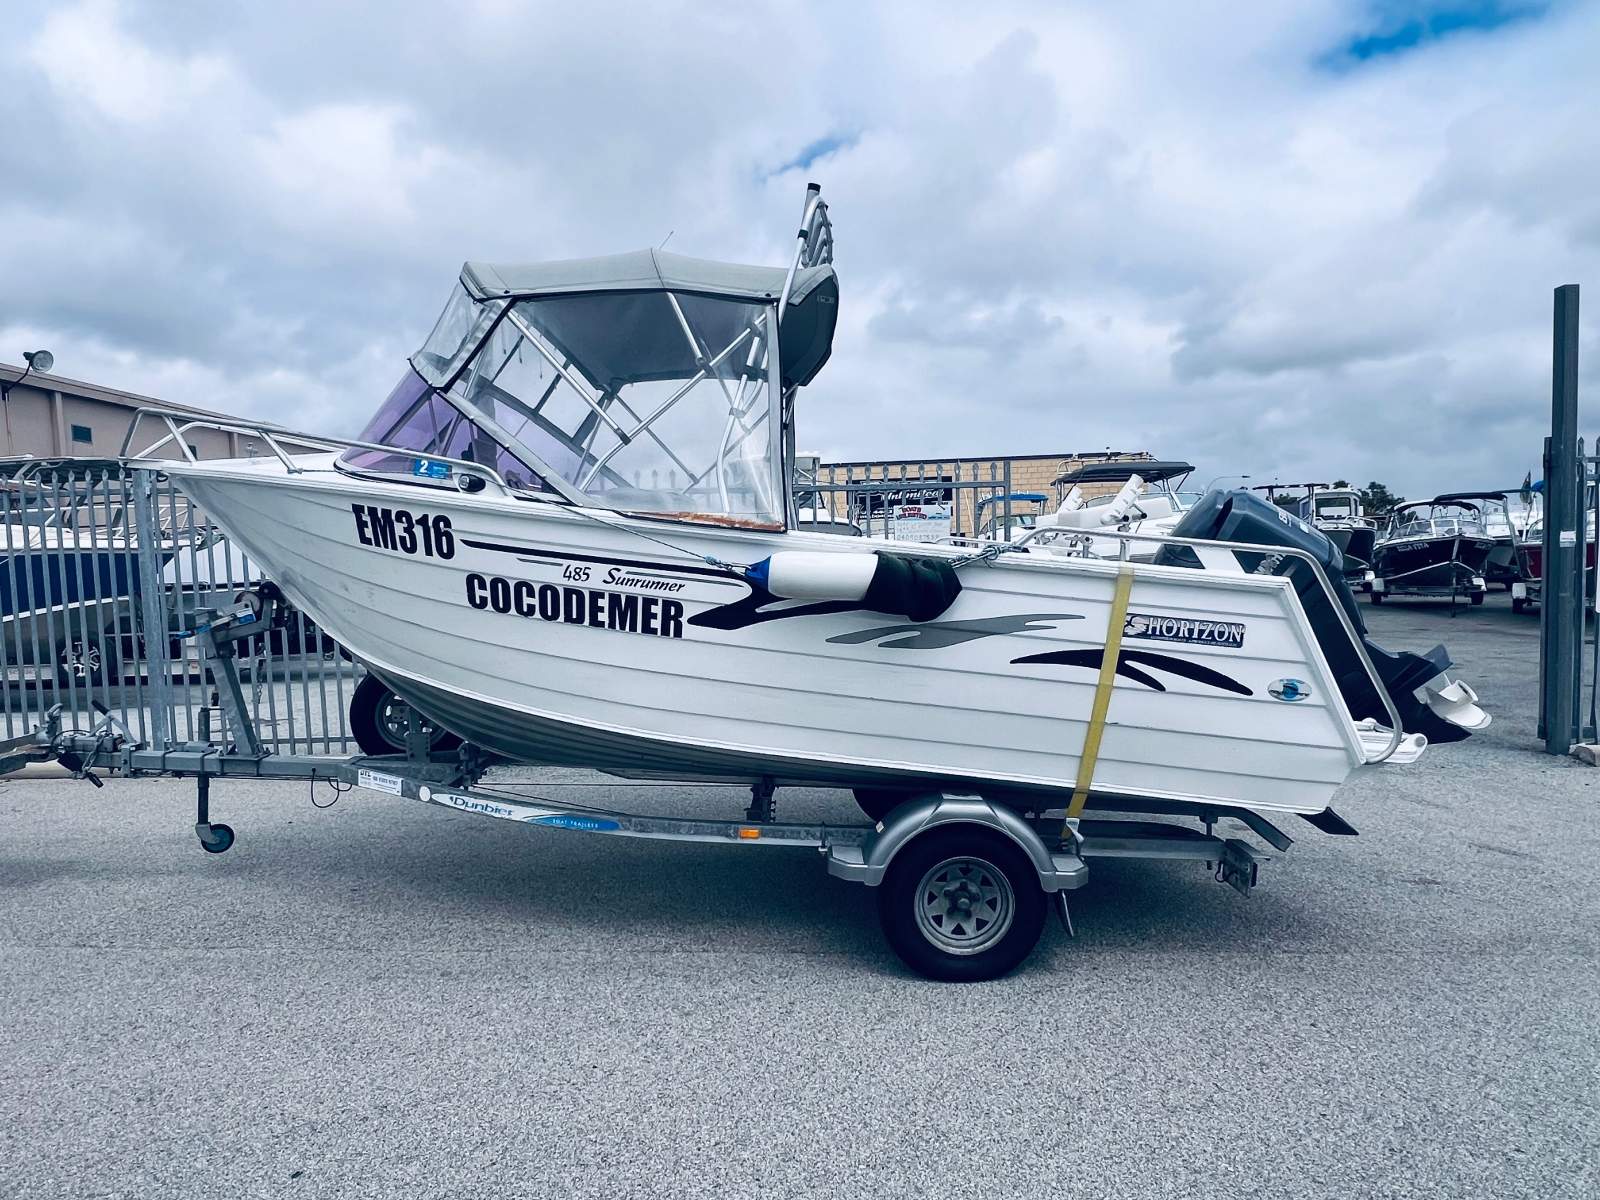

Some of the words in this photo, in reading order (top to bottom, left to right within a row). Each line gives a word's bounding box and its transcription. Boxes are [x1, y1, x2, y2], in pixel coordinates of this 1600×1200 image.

[419, 460, 429, 473] 2
[351, 503, 455, 560] EM316
[562, 563, 592, 583] 485
[602, 567, 686, 594] Sunrunner
[465, 573, 684, 639] COCODEMER
[1147, 616, 1243, 642] HORIZON
[453, 796, 513, 817] Dunbier
